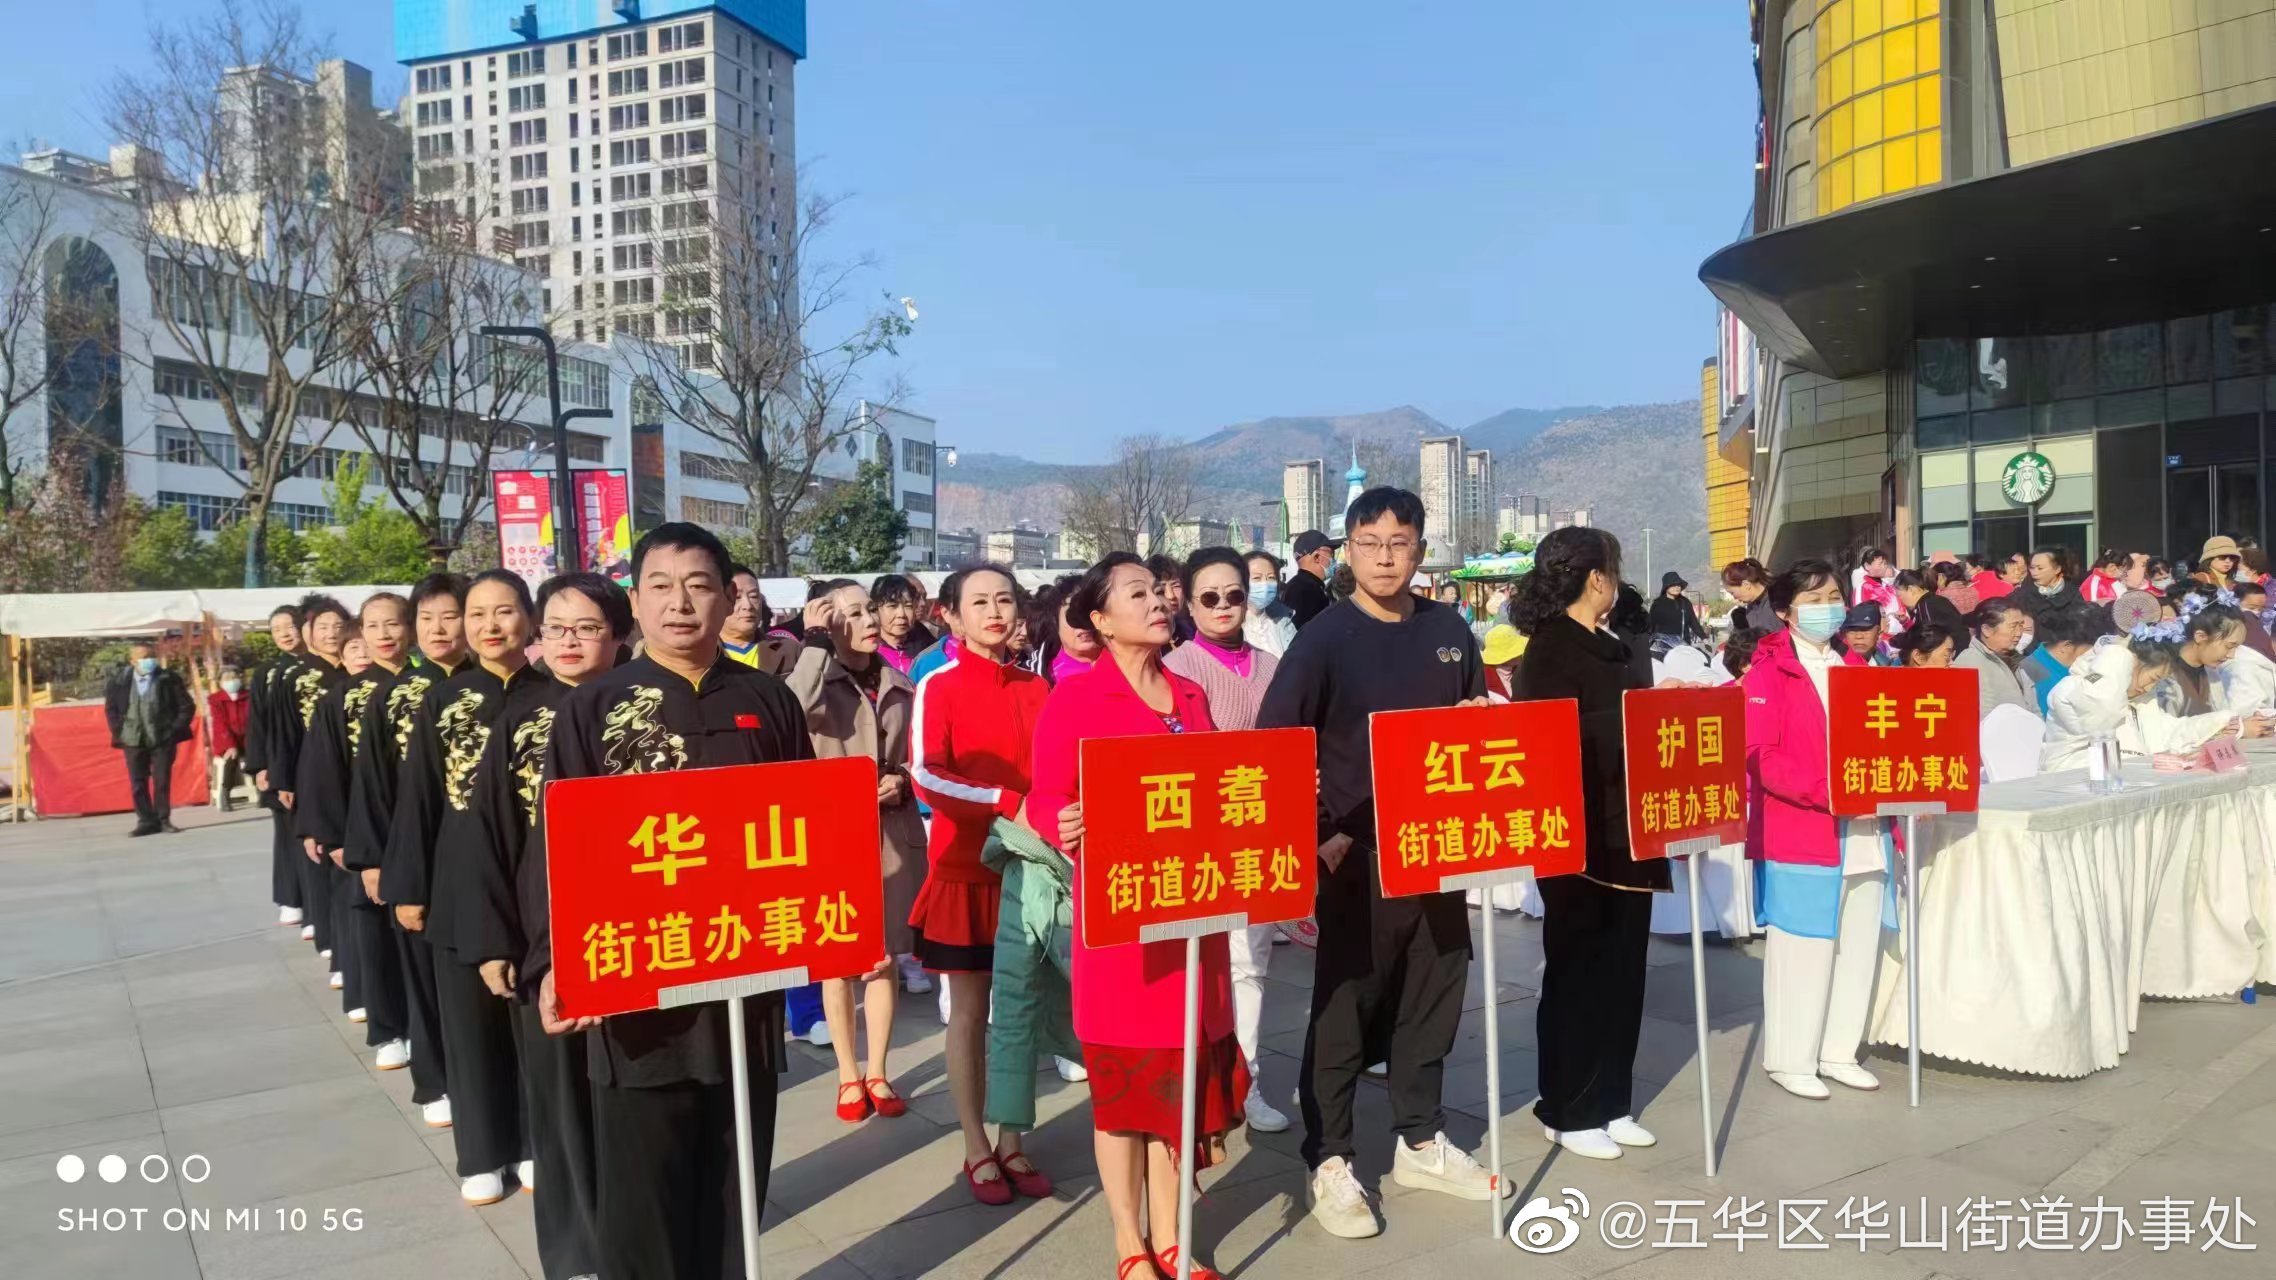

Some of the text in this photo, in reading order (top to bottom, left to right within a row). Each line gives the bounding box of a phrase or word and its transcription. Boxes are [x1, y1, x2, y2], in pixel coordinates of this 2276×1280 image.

[1658, 716, 1724, 769] 护国
[1865, 693, 1948, 740] 丰宁
[1424, 739, 1526, 795] 红云
[1843, 755, 1970, 796] 街道办事处
[1140, 765, 1269, 833] 西翥
[1642, 781, 1741, 834] 街道办事处
[628, 805, 808, 886] 华山
[1397, 806, 1571, 869] 街道办事处
[1106, 844, 1302, 915] 街道办事处
[582, 891, 860, 982] 街道办事处
